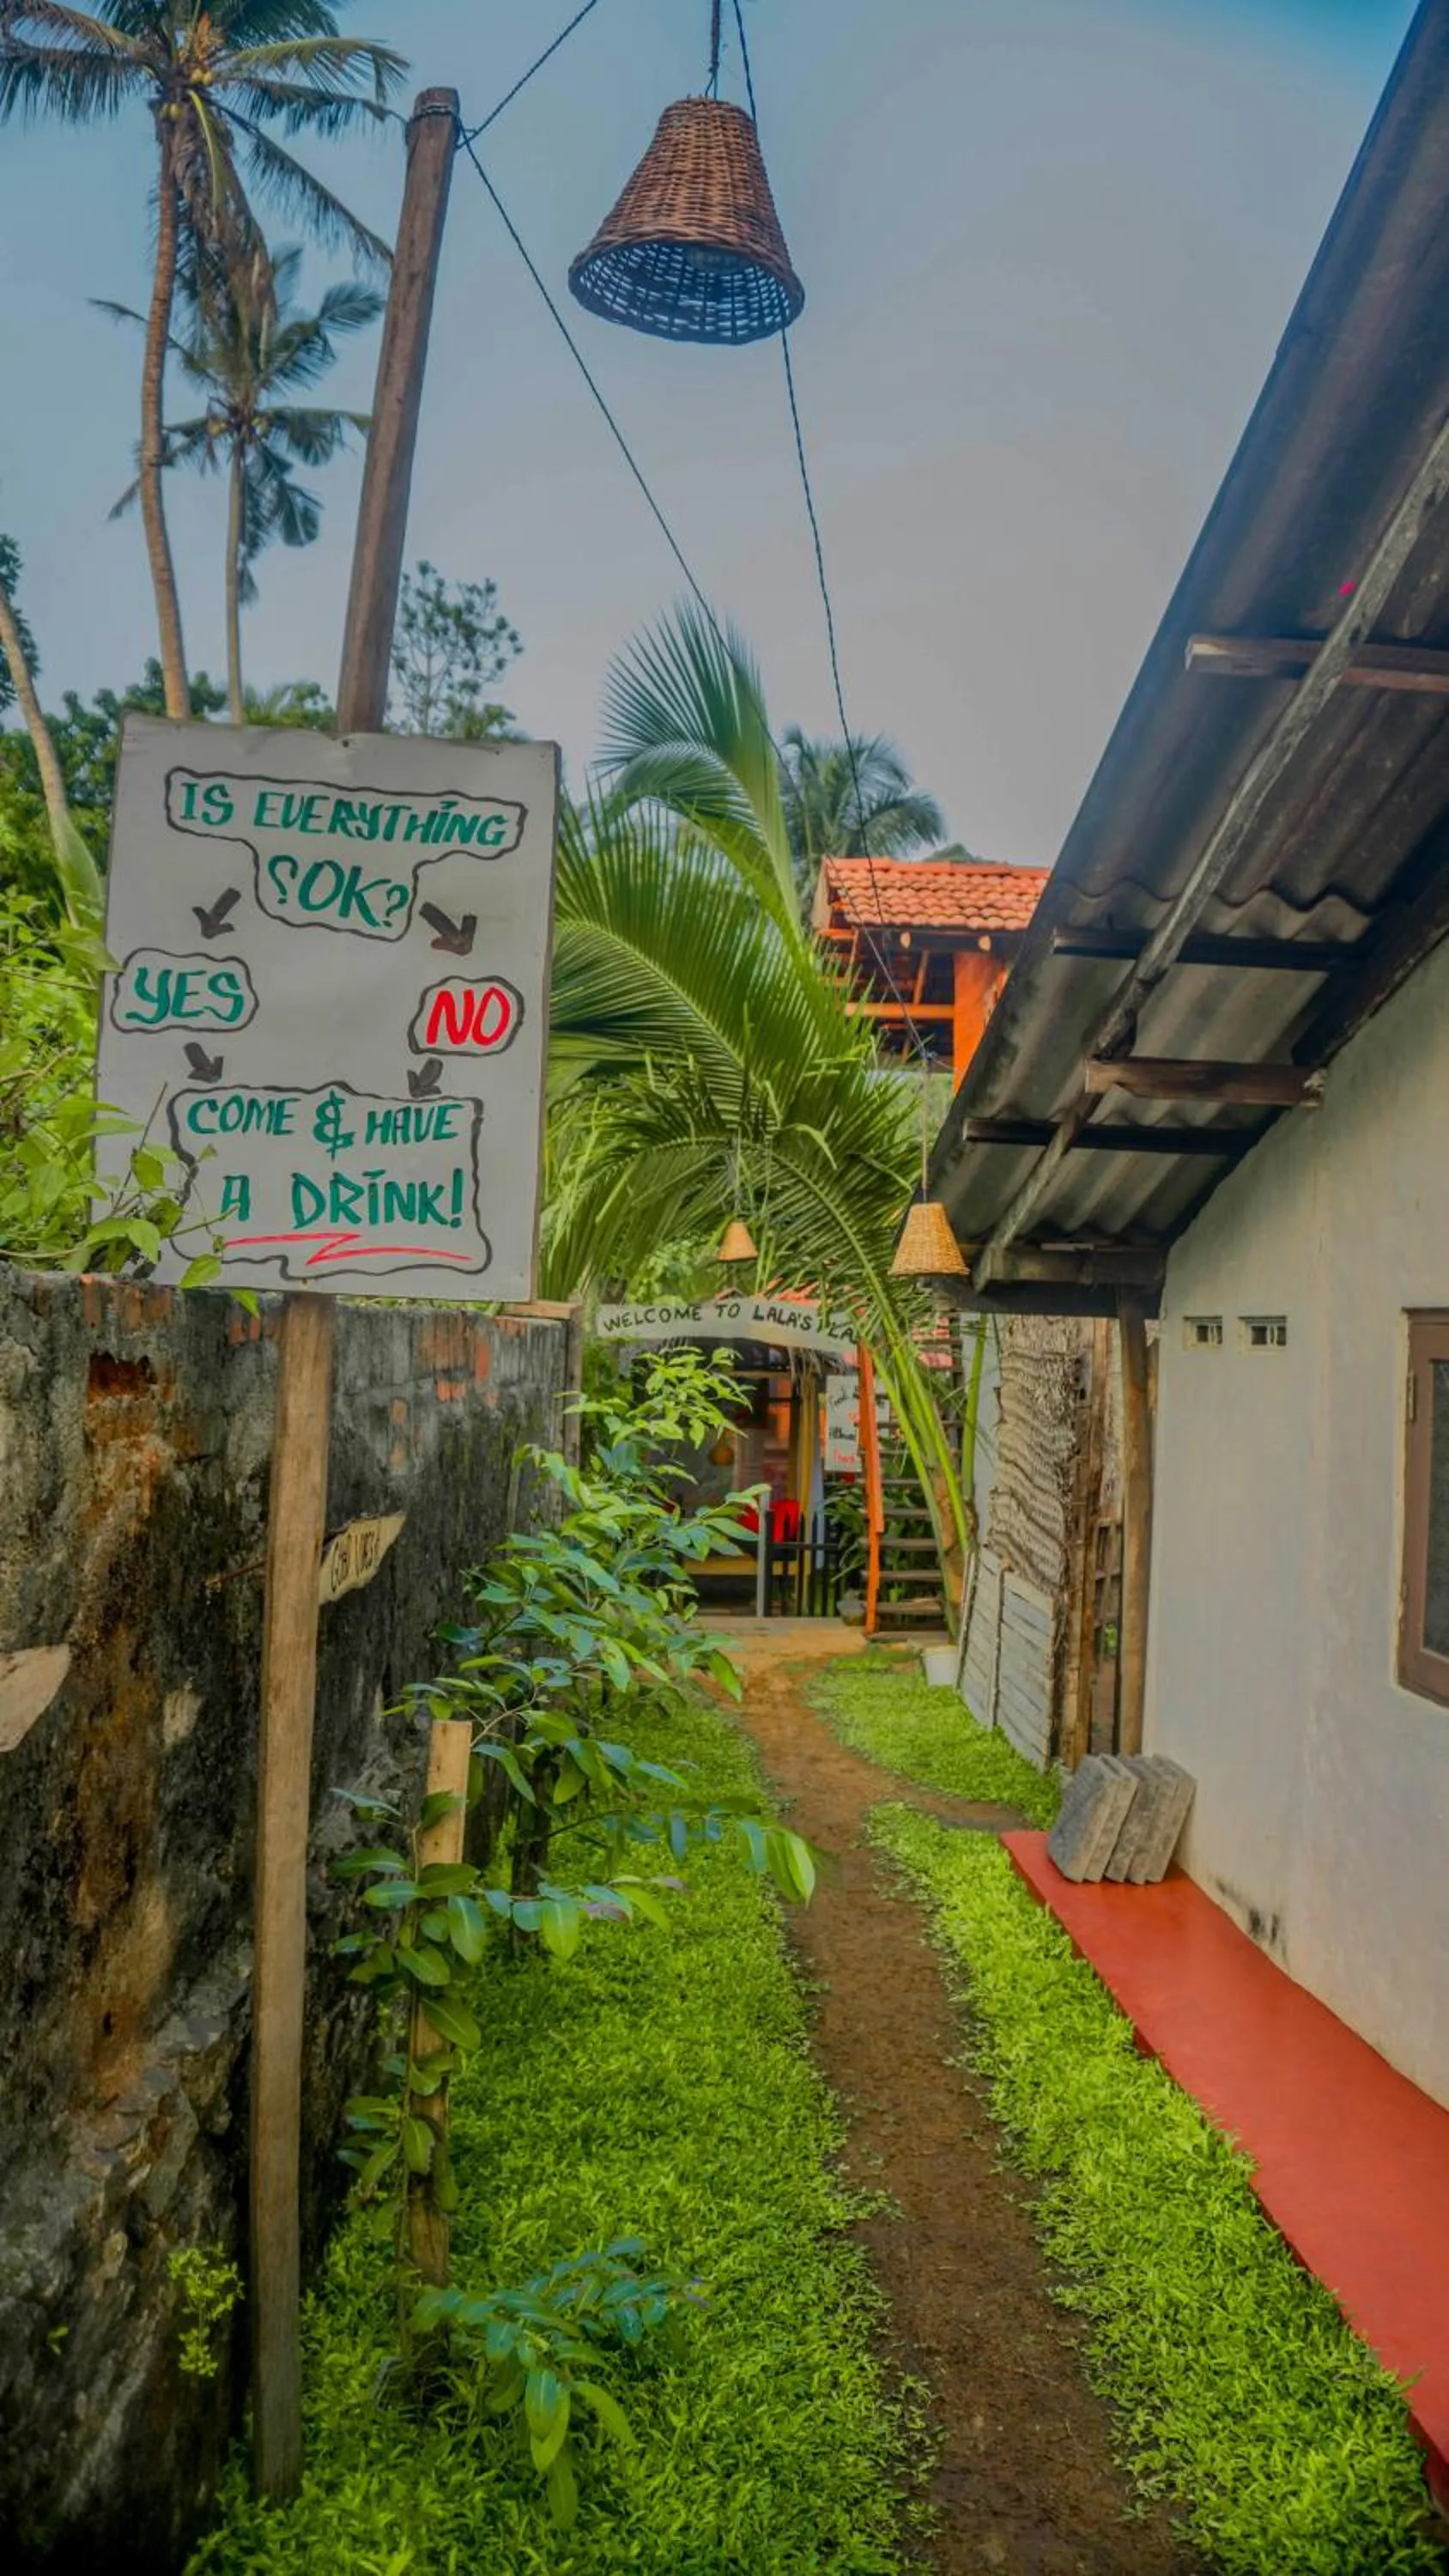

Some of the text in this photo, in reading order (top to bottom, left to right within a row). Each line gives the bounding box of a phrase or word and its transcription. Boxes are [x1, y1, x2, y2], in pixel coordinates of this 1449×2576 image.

[179, 783, 508, 848] IS EVERYTHING
[125, 967, 244, 1024] YES
[425, 987, 511, 1046] NO
[186, 1091, 464, 1160] COME & HAVE
[221, 1168, 464, 1229] A DRINK!
[603, 1305, 701, 1331] WELCOME
[715, 1303, 741, 1318] TO
[752, 1304, 812, 1331] LALA'S
